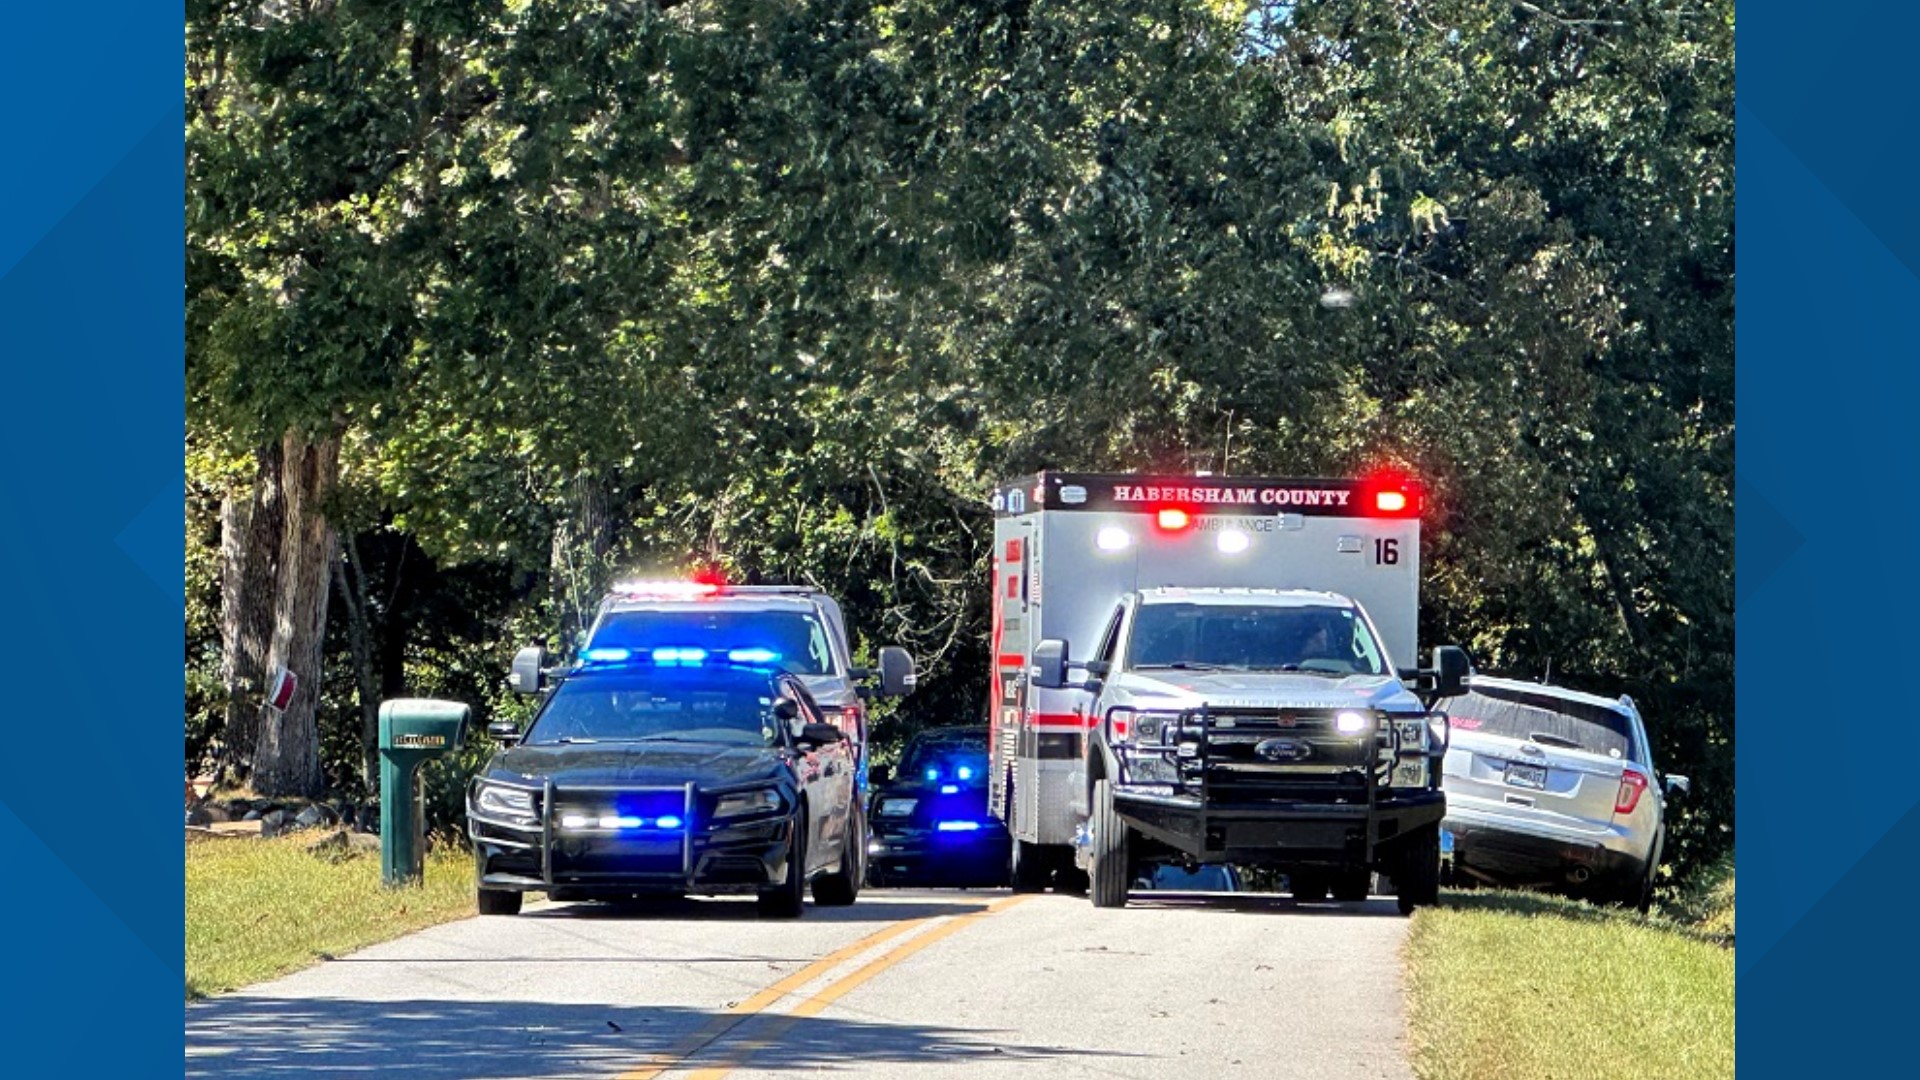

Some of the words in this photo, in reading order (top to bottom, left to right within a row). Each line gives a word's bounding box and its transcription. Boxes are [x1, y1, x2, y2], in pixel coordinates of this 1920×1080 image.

[1113, 486, 1257, 504] HABERSHAM
[1260, 489, 1350, 505] COUNTY
[1375, 538, 1398, 565] 16
